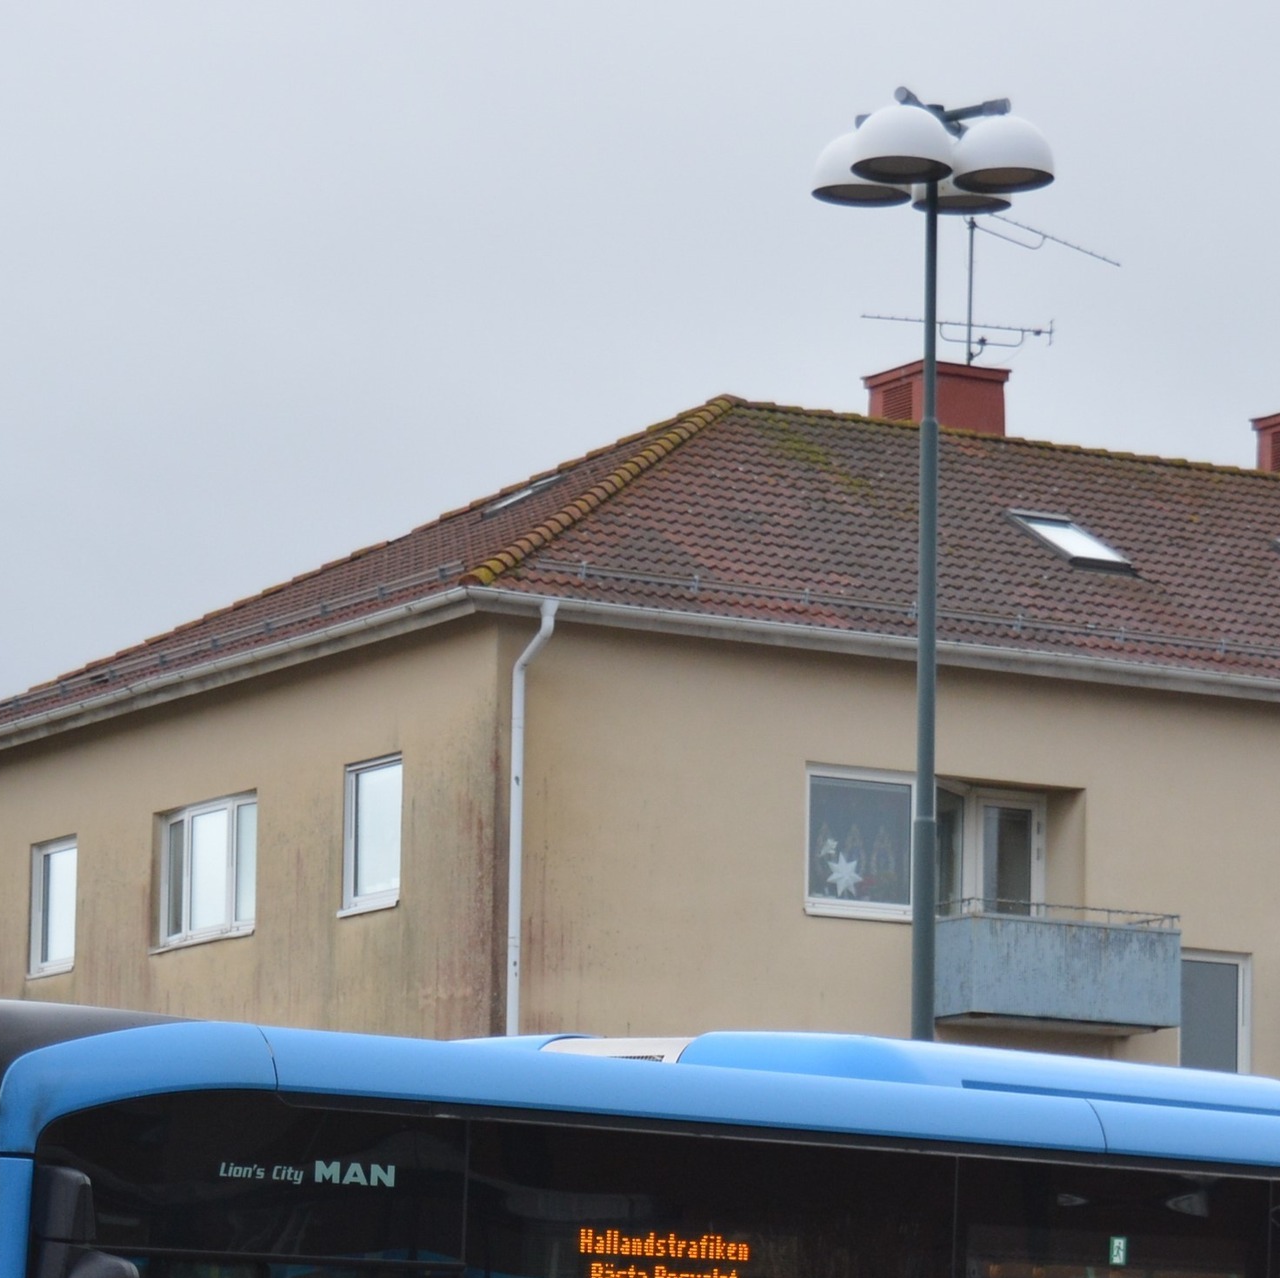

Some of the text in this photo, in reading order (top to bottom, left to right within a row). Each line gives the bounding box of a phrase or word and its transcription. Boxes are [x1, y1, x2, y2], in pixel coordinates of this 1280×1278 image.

[219, 1156, 396, 1188] Lion's City MAN
[579, 1228, 750, 1262] Hallandstrafiken
